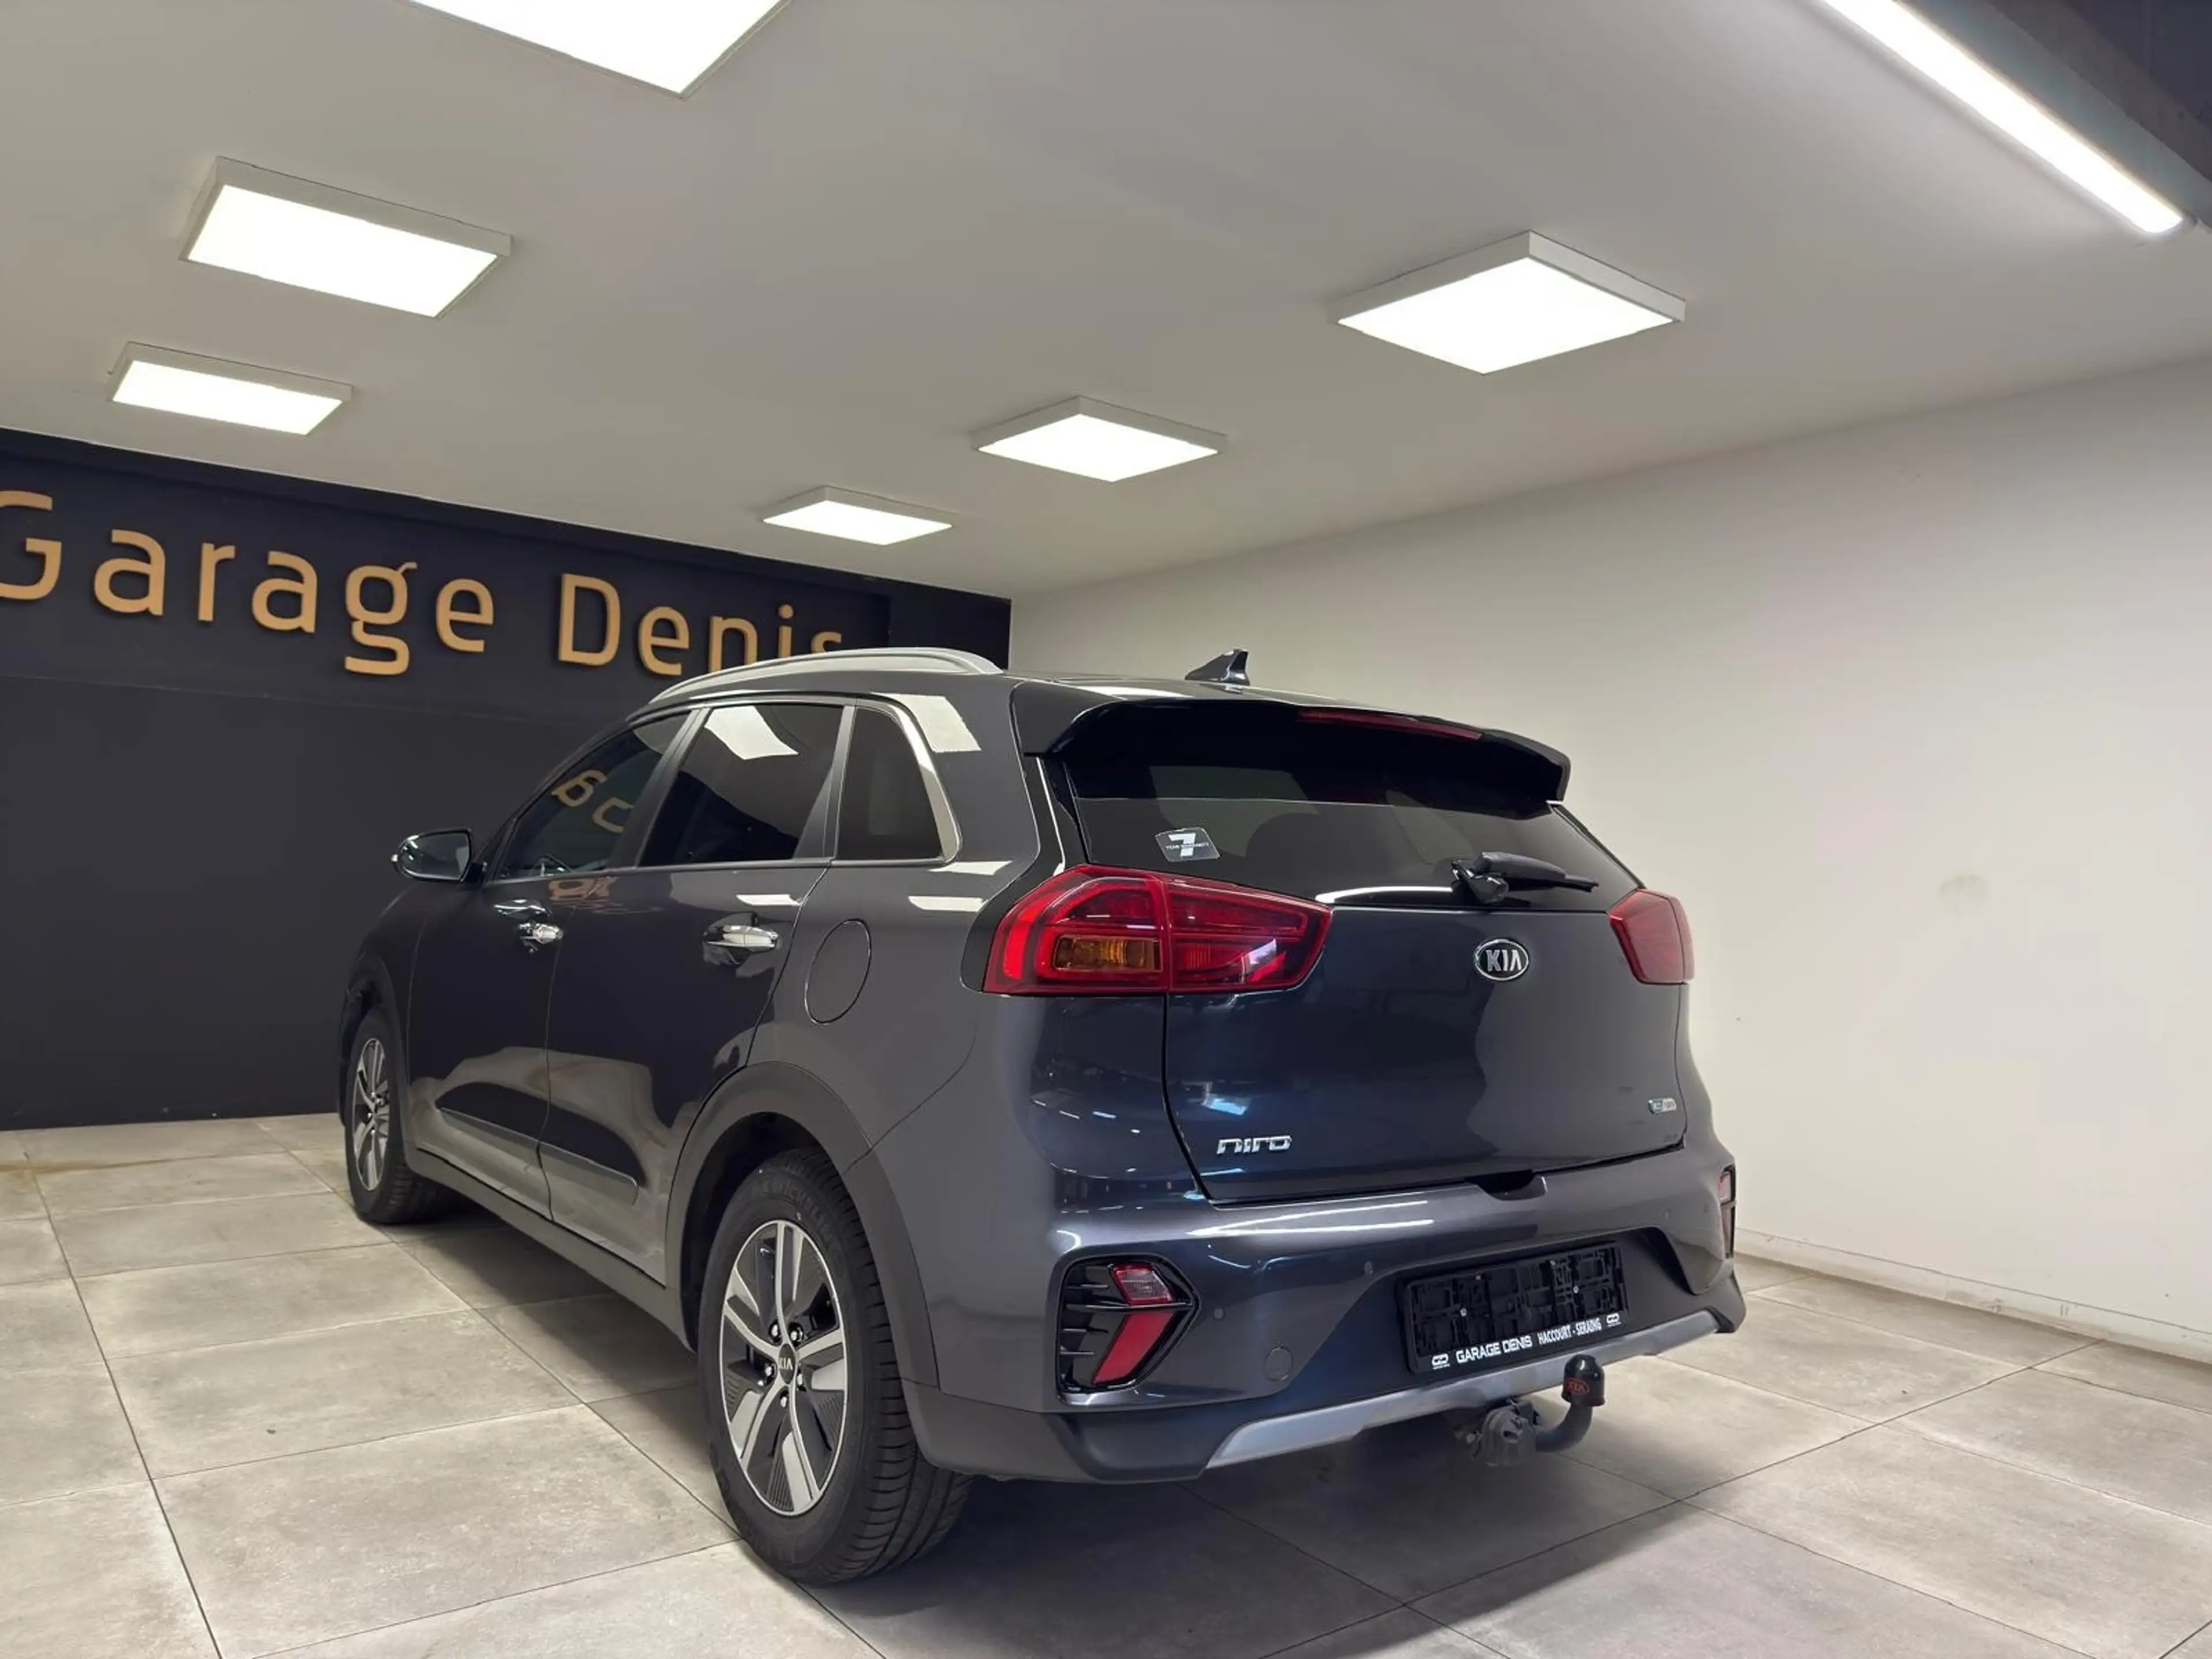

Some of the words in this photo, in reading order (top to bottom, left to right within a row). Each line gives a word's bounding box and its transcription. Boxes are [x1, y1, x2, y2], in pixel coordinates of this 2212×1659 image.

[0, 490, 494, 675] Garage
[1168, 832, 1196, 857] 7
[1486, 949, 1521, 971] KIA
[1456, 1342, 1501, 1363] GARAGE
[1502, 1335, 1532, 1353] DENIS
